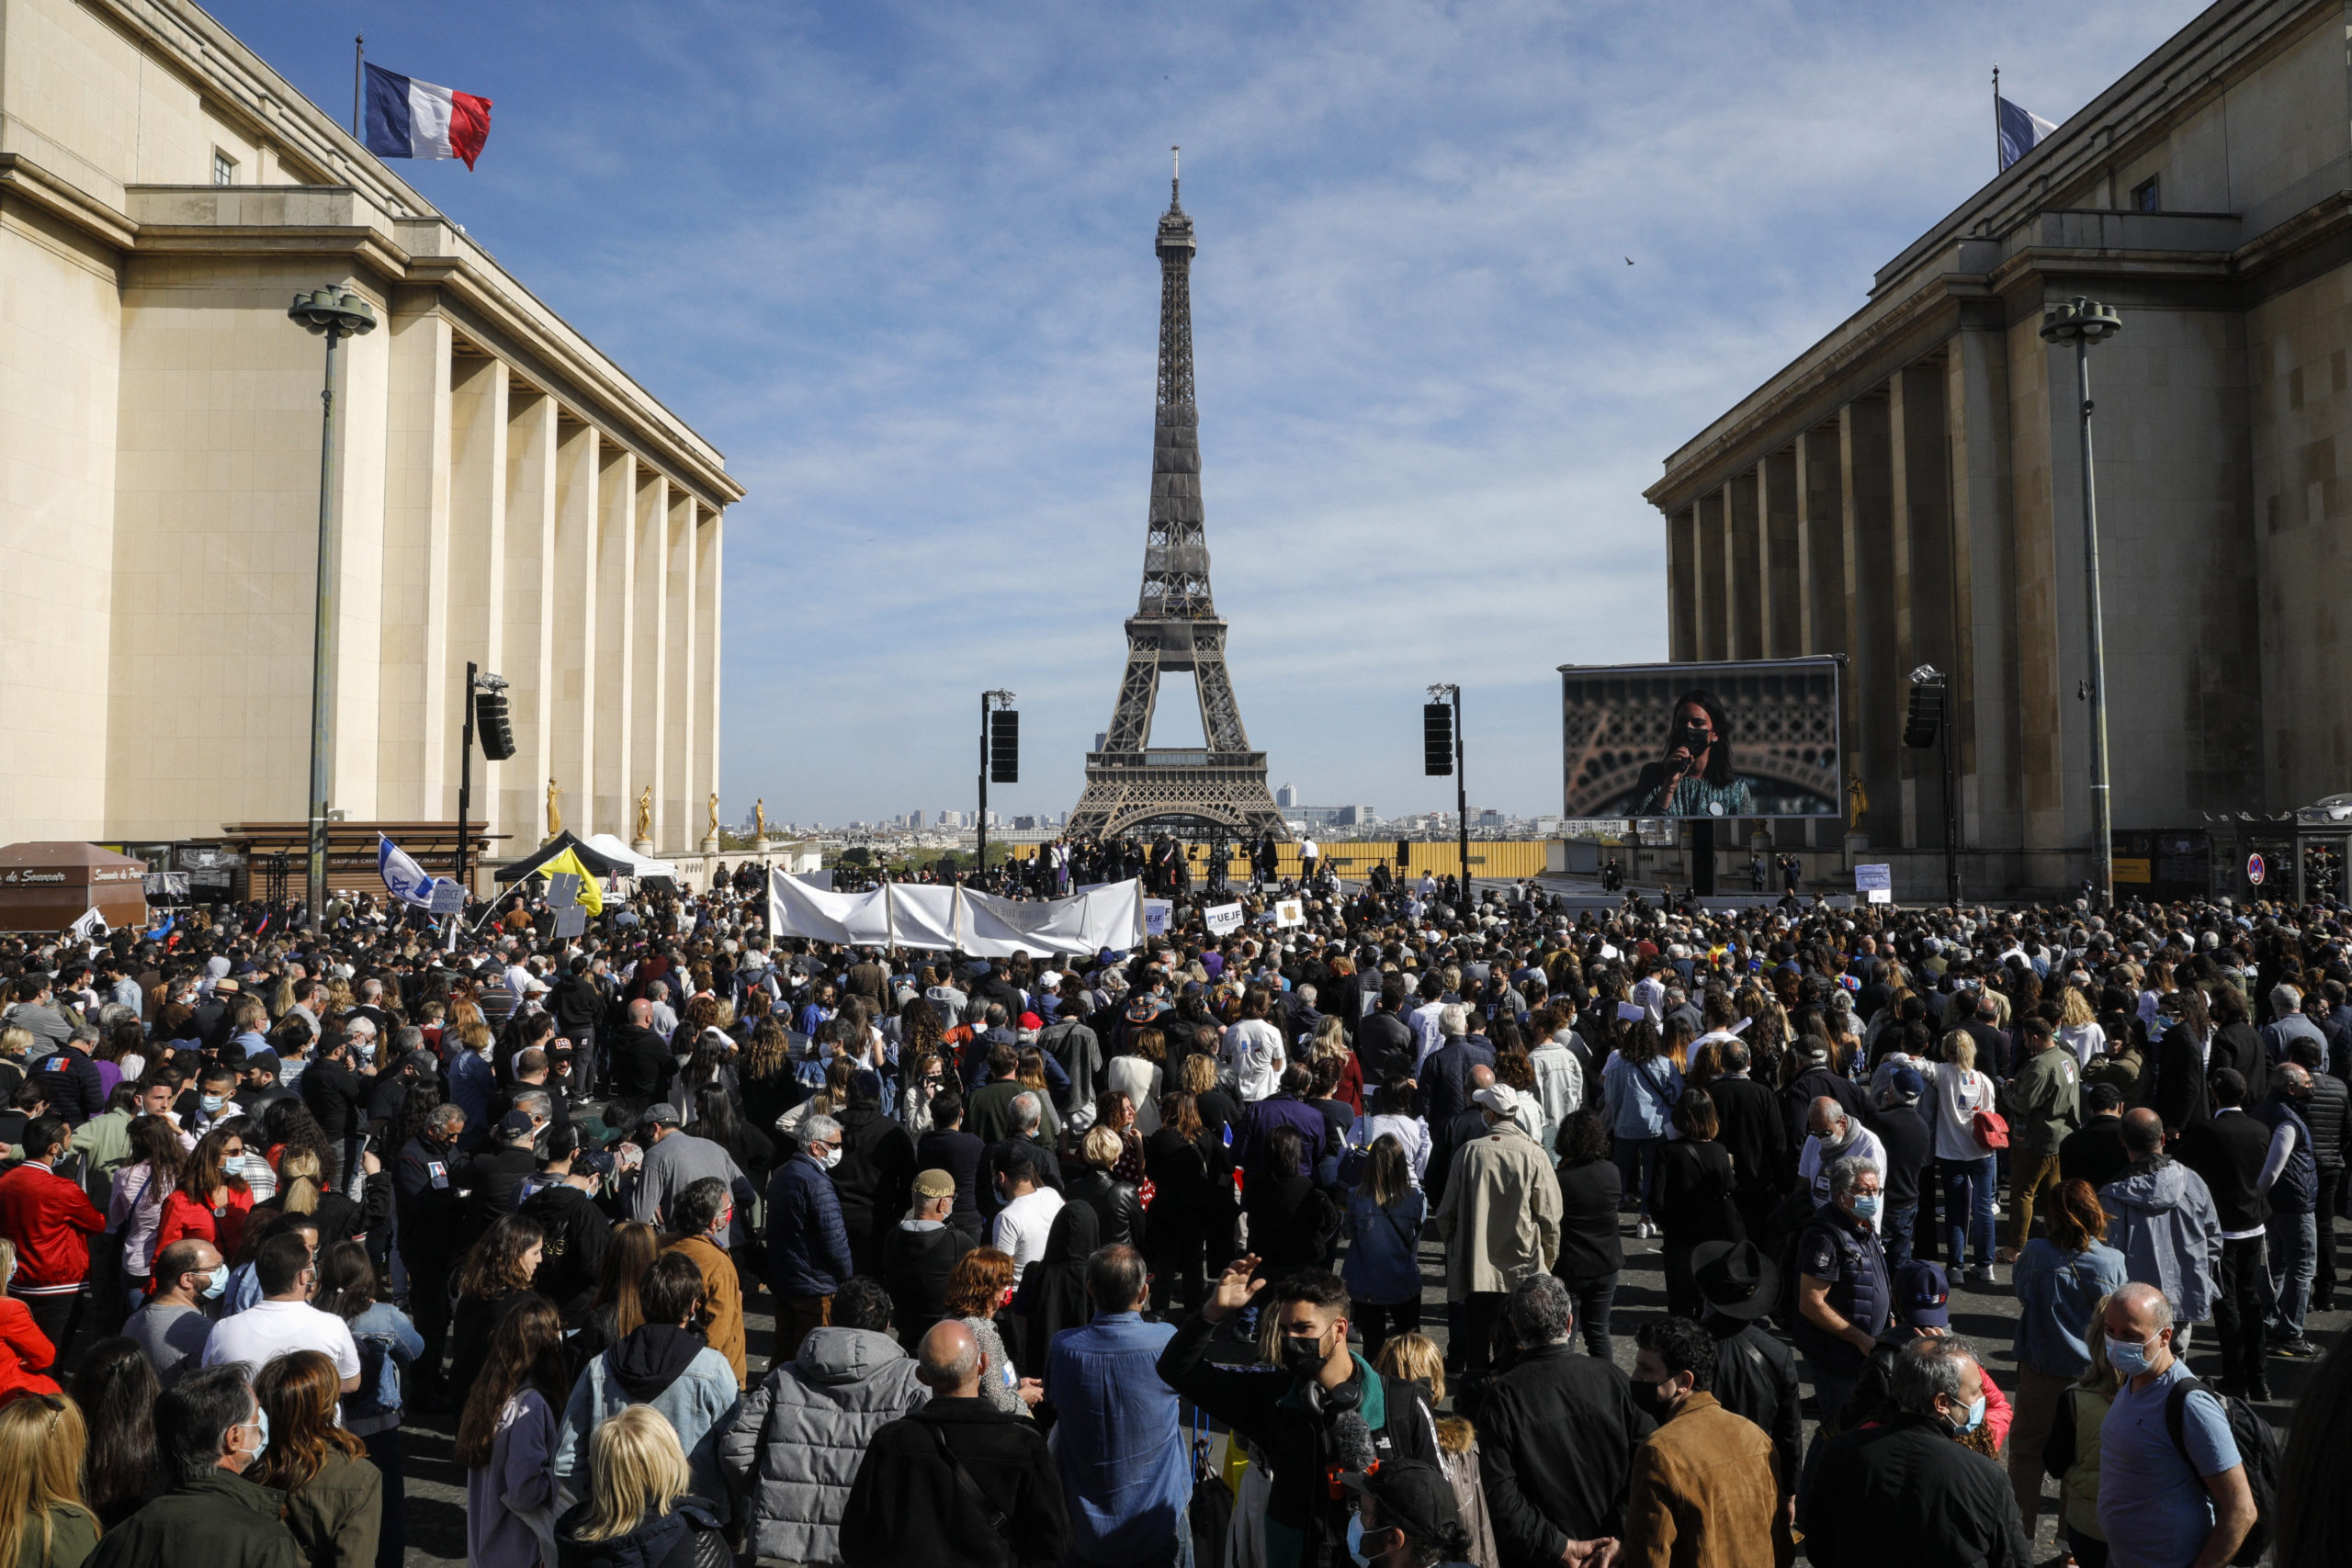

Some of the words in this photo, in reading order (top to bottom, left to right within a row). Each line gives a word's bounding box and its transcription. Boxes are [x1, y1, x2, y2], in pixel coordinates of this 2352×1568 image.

[6, 871, 18, 883] de
[21, 869, 66, 883] Souvenir
[433, 888, 459, 899] JUSTICE
[1217, 910, 1241, 922] UEJF
[919, 1185, 954, 1198] ISRAEL
